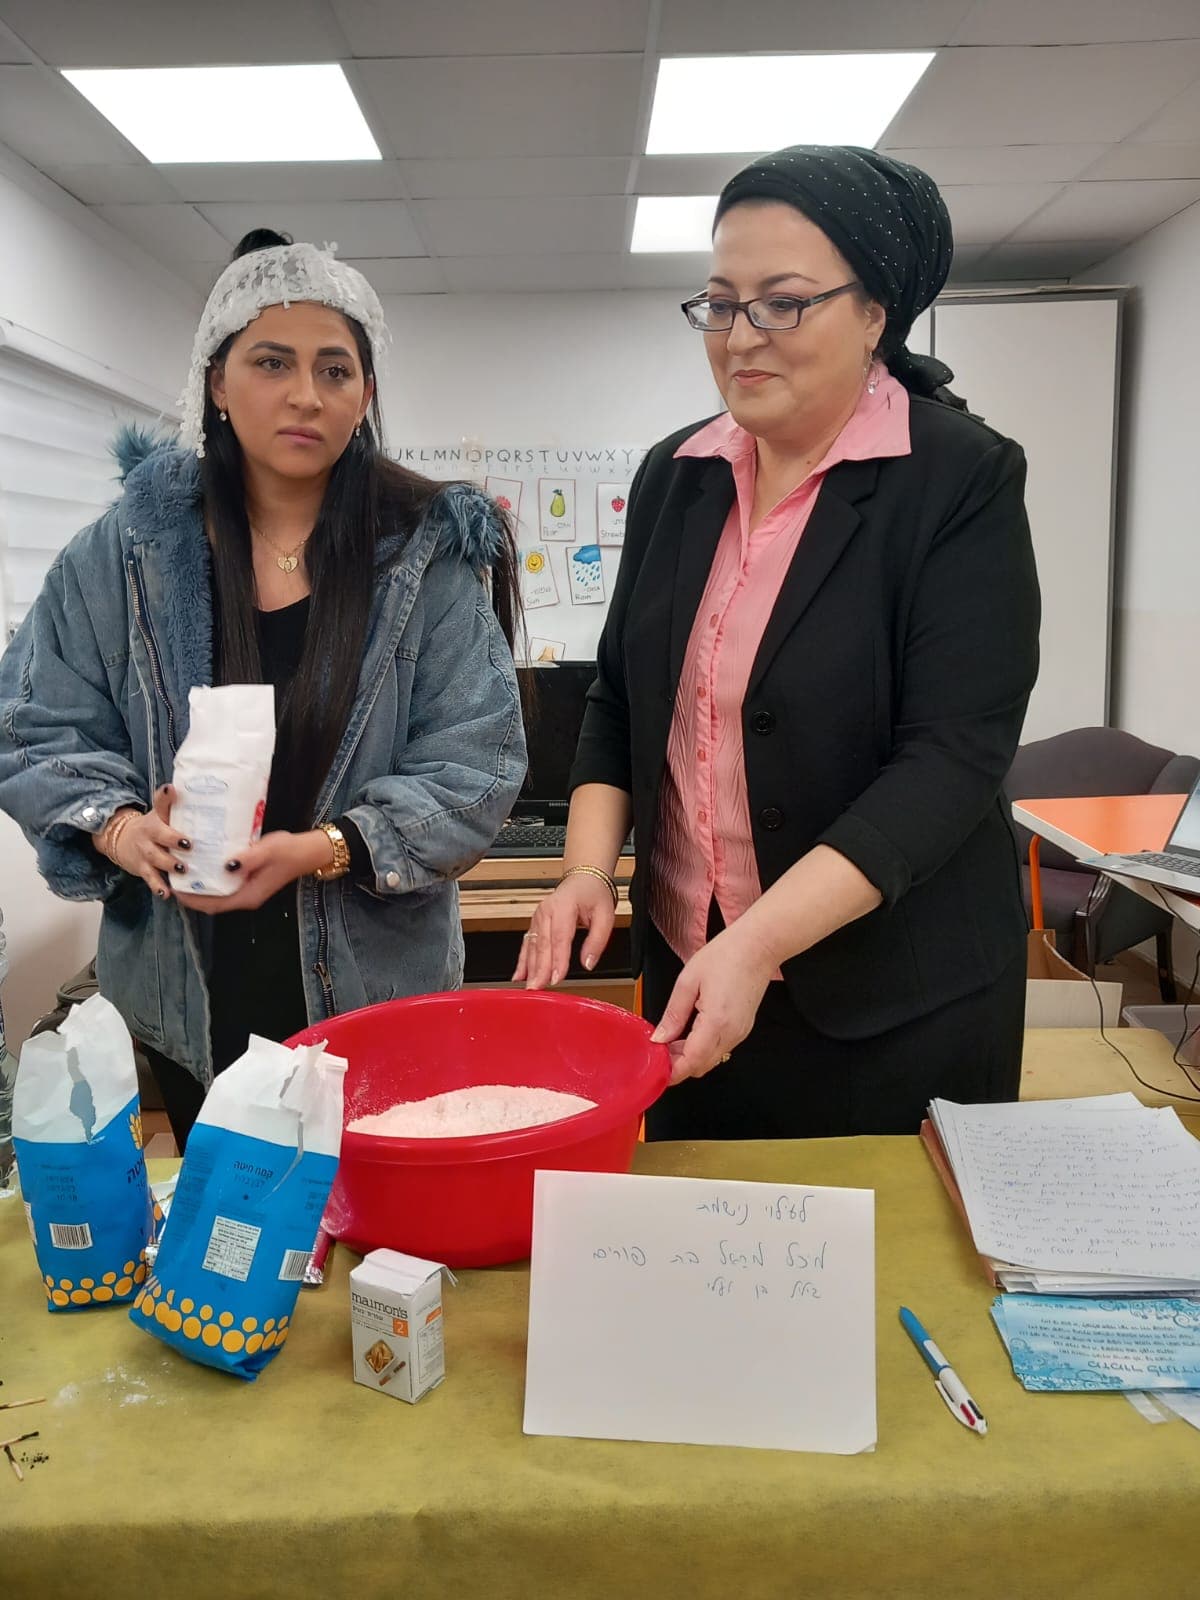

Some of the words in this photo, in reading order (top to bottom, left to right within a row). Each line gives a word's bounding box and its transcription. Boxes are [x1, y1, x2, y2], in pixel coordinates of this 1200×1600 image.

[233, 1160, 254, 1174] חיטה
[255, 1165, 274, 1180] קמח
[592, 1245, 647, 1267] פורים
[668, 1250, 700, 1265] בת
[351, 1291, 409, 1320] maimon's
[395, 1321, 404, 1334] 2
[1087, 1359, 1144, 1374] מזמור
